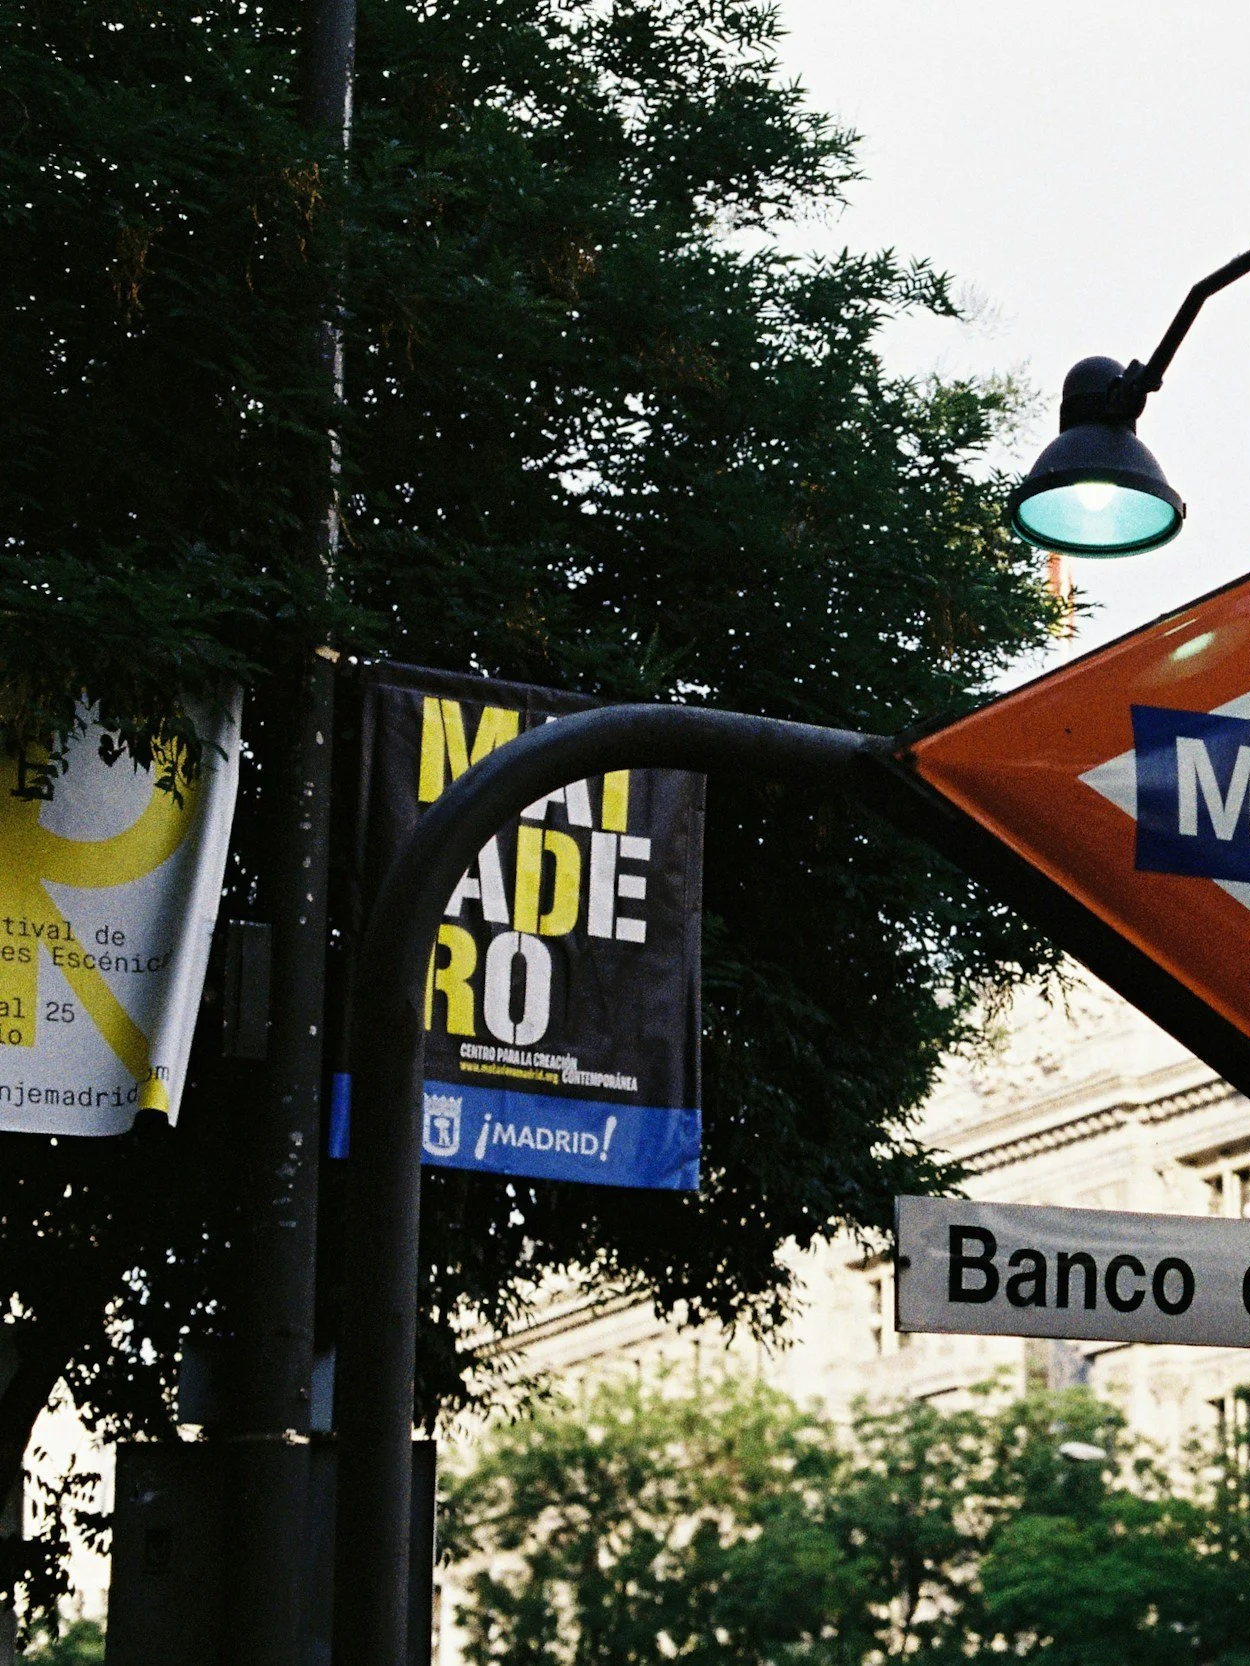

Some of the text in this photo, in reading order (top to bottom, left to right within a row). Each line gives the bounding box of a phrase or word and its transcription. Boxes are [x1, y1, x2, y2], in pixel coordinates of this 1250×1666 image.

[95, 925, 125, 946] de
[53, 946, 169, 973] Escénic
[424, 924, 551, 1046] RO
[46, 1001, 75, 1023] 25
[475, 1112, 617, 1162] ¡MADRID!
[947, 1224, 1195, 1316] Banco
